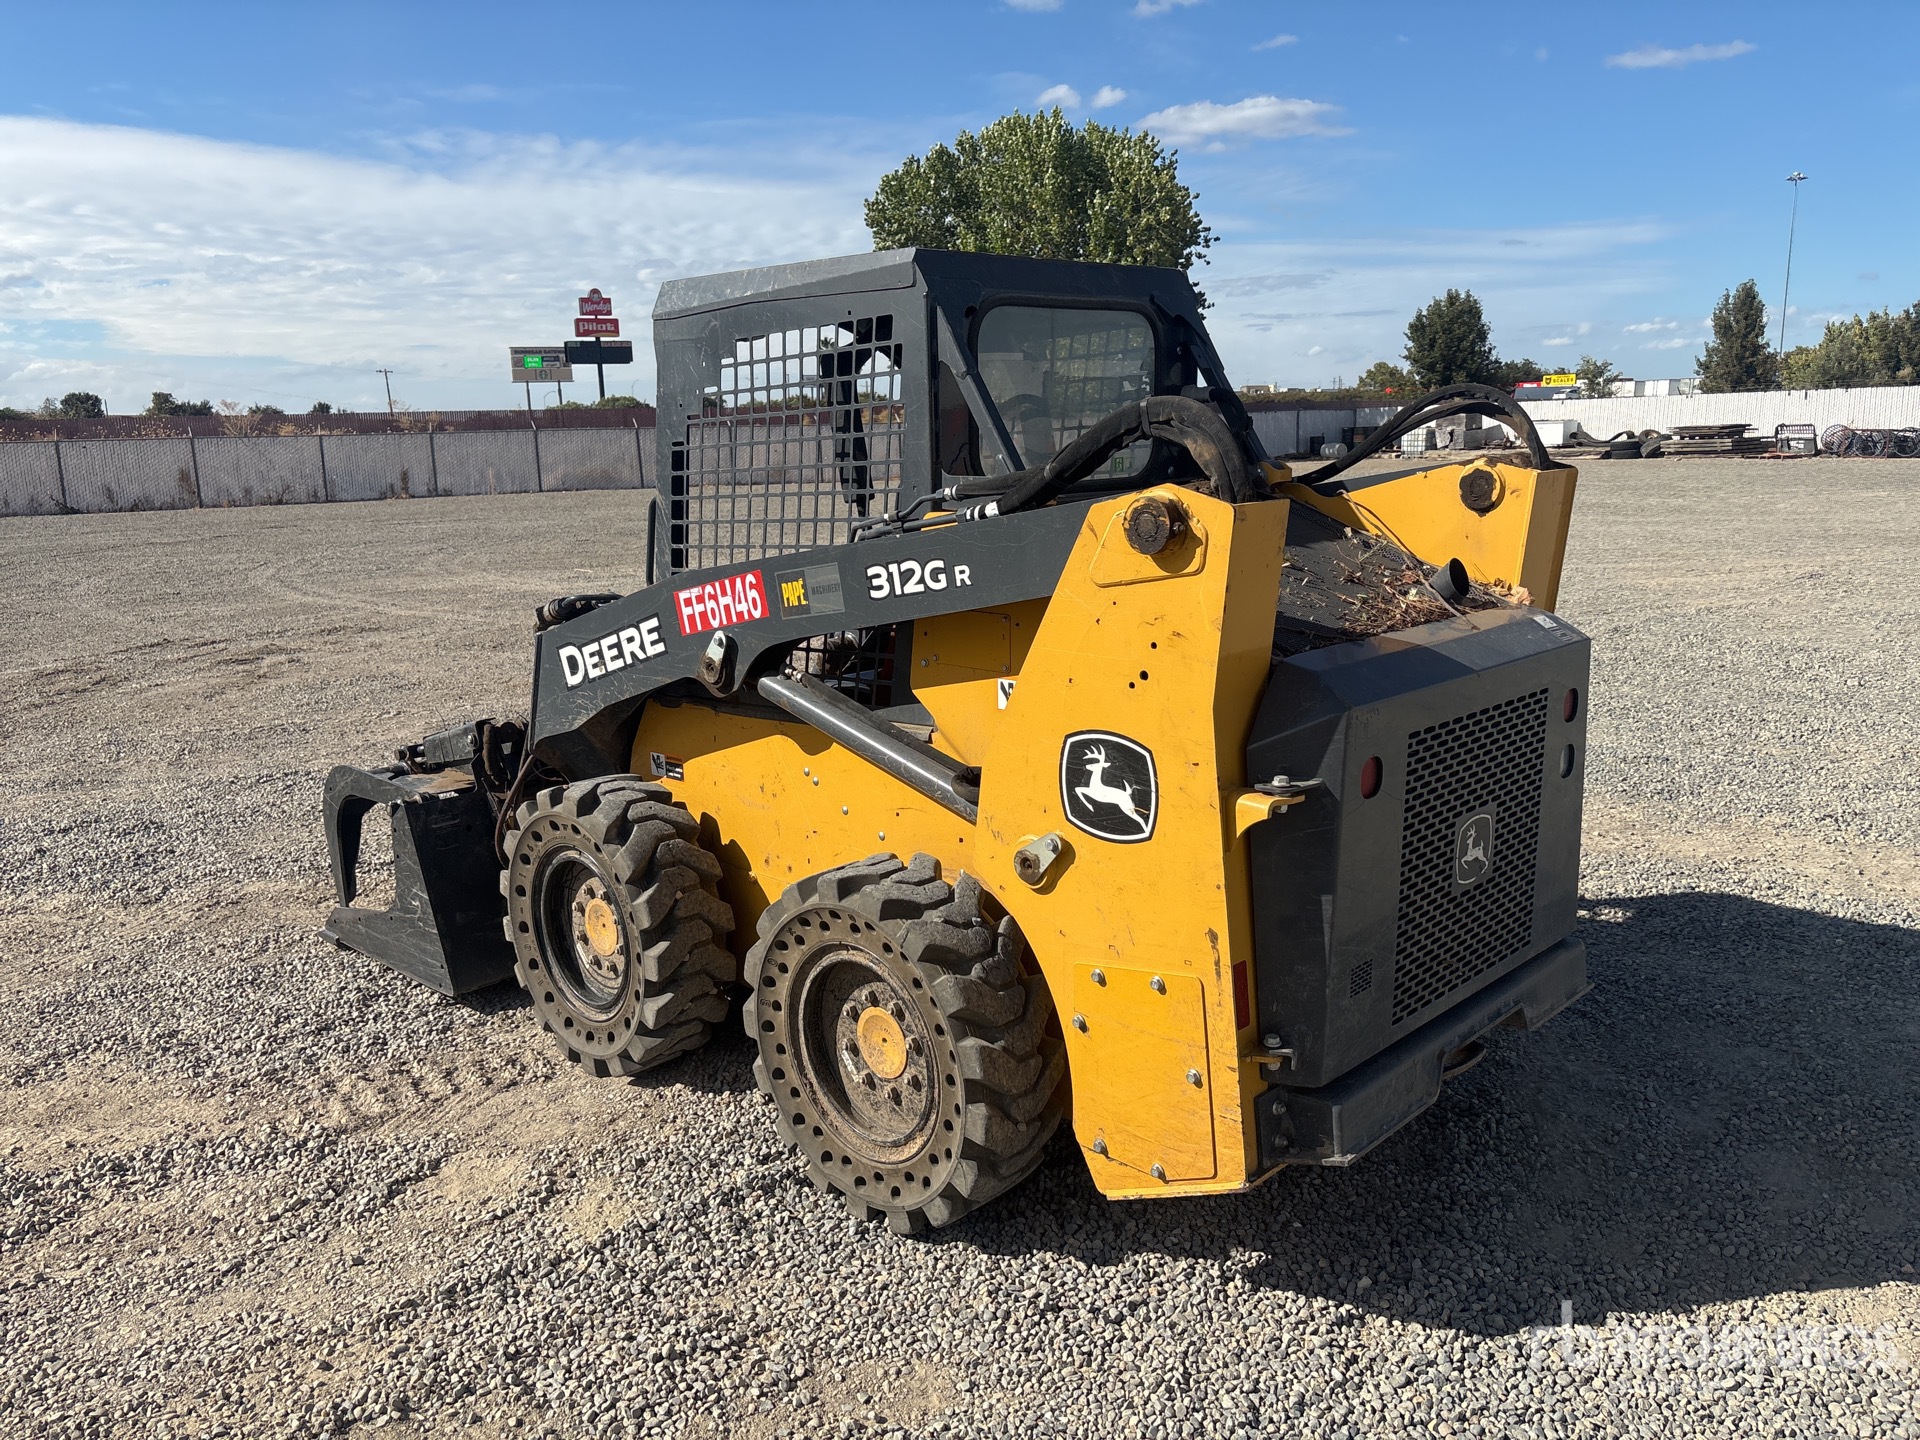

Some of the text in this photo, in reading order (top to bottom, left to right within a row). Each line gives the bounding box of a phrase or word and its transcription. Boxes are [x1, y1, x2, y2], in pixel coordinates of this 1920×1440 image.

[578, 321, 615, 333] Pilot
[678, 573, 762, 634] FF6H46
[865, 559, 972, 599] 312G R
[558, 616, 666, 687] DEERE
